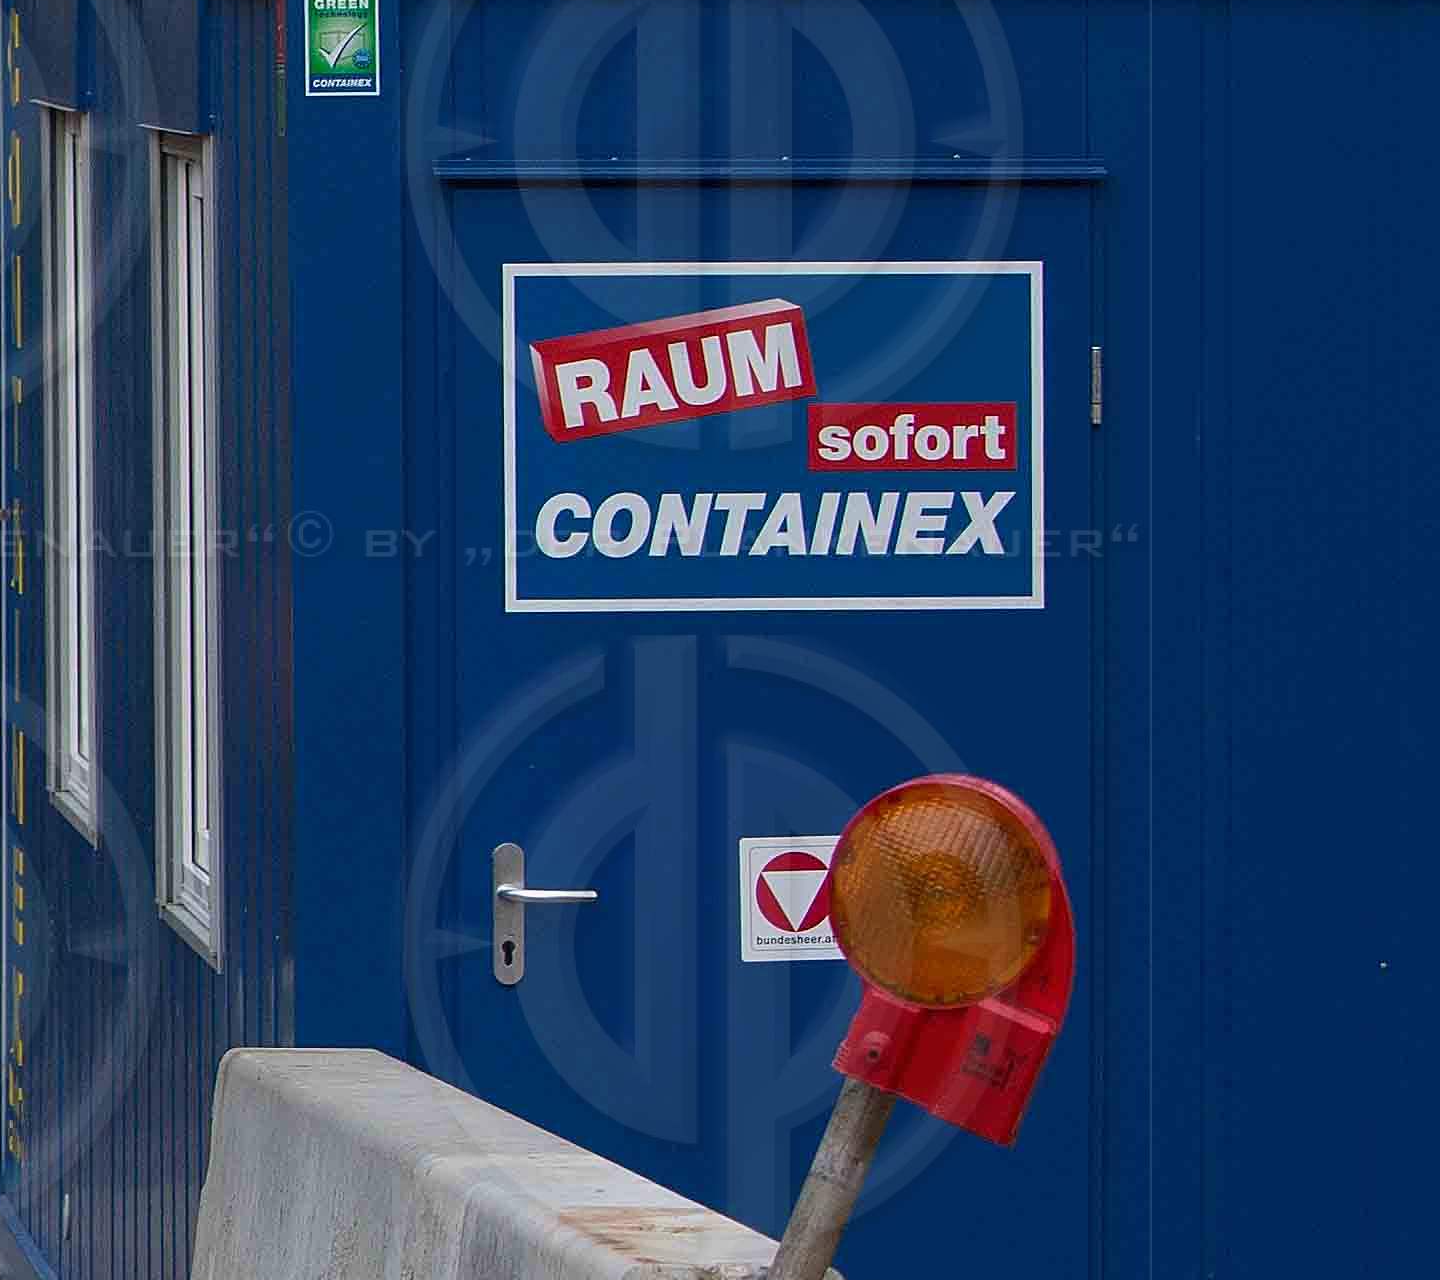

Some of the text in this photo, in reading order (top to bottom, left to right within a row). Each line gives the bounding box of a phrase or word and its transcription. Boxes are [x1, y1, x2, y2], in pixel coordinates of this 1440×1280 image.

[312, 79, 372, 88] CONTAINEX
[553, 320, 805, 430] RAUM
[817, 413, 1007, 461] sofort
[535, 491, 1017, 559] CONTAINEX
